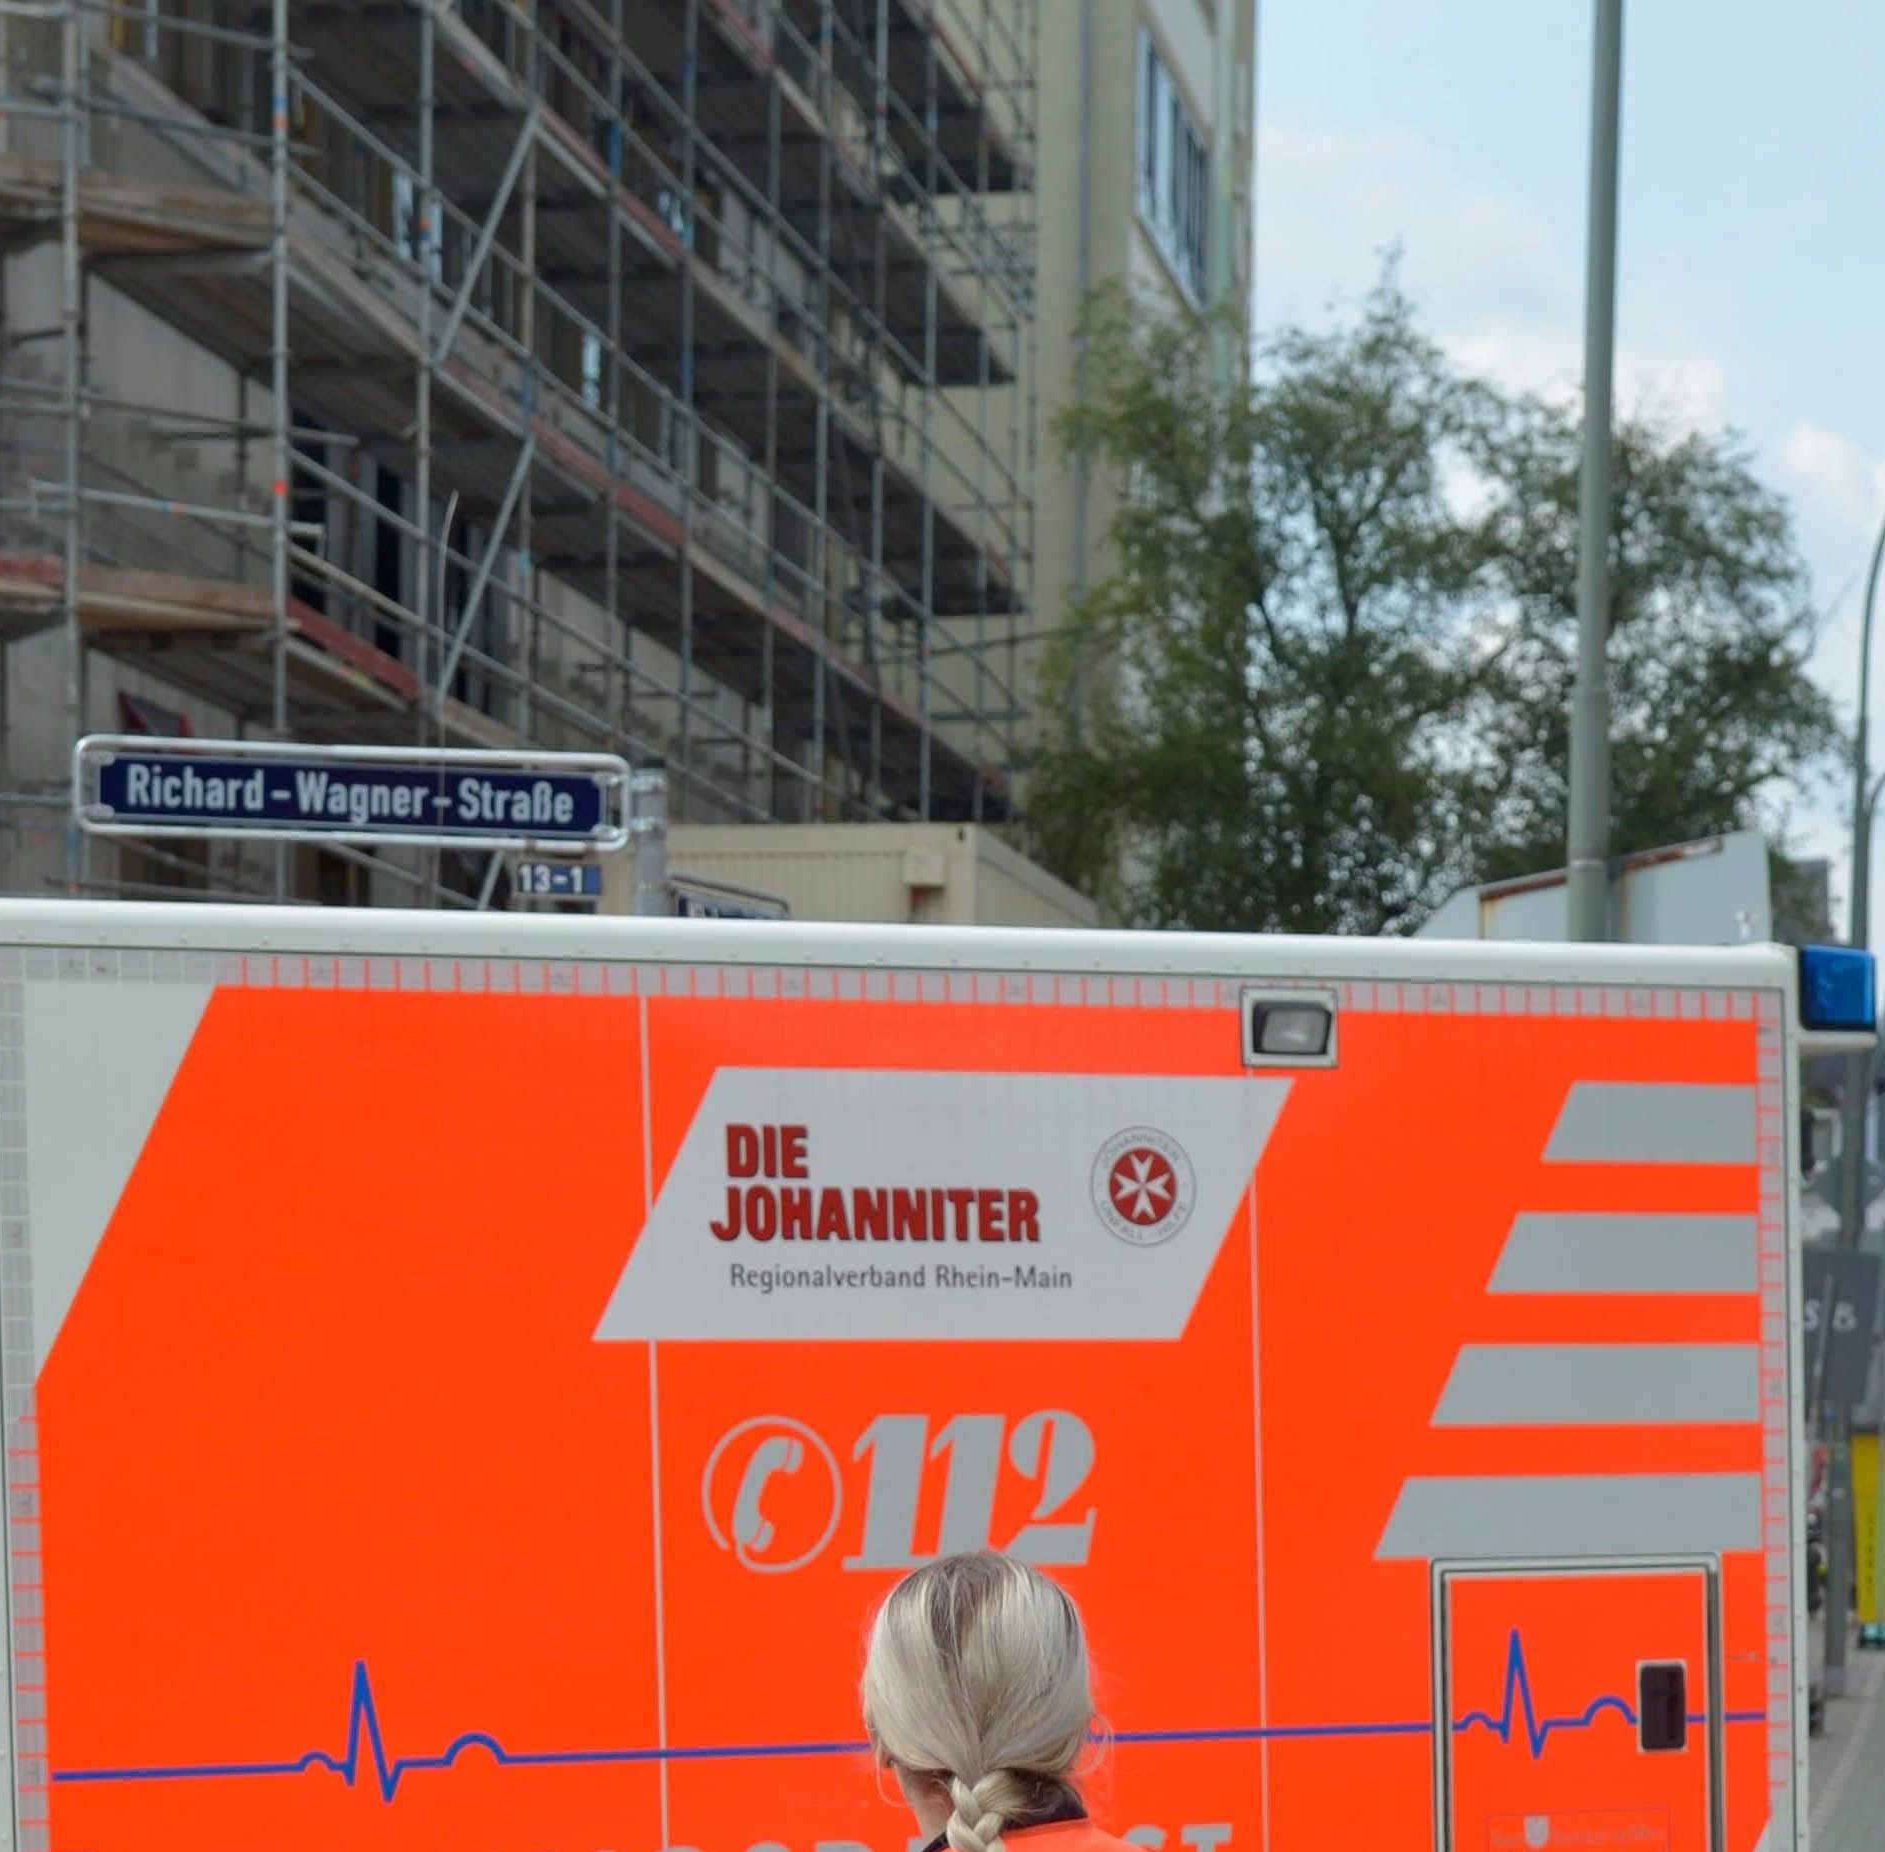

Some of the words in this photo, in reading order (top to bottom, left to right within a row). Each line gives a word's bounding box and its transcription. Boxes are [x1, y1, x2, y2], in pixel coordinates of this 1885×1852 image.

[517, 863, 585, 895] 13-1
[726, 1123, 809, 1179] DIE
[709, 1184, 1041, 1242] JOHANNITER
[729, 1263, 927, 1295] Regionalverband
[935, 1266, 1073, 1290] Rhein-Main
[843, 1408, 1098, 1571] 112
